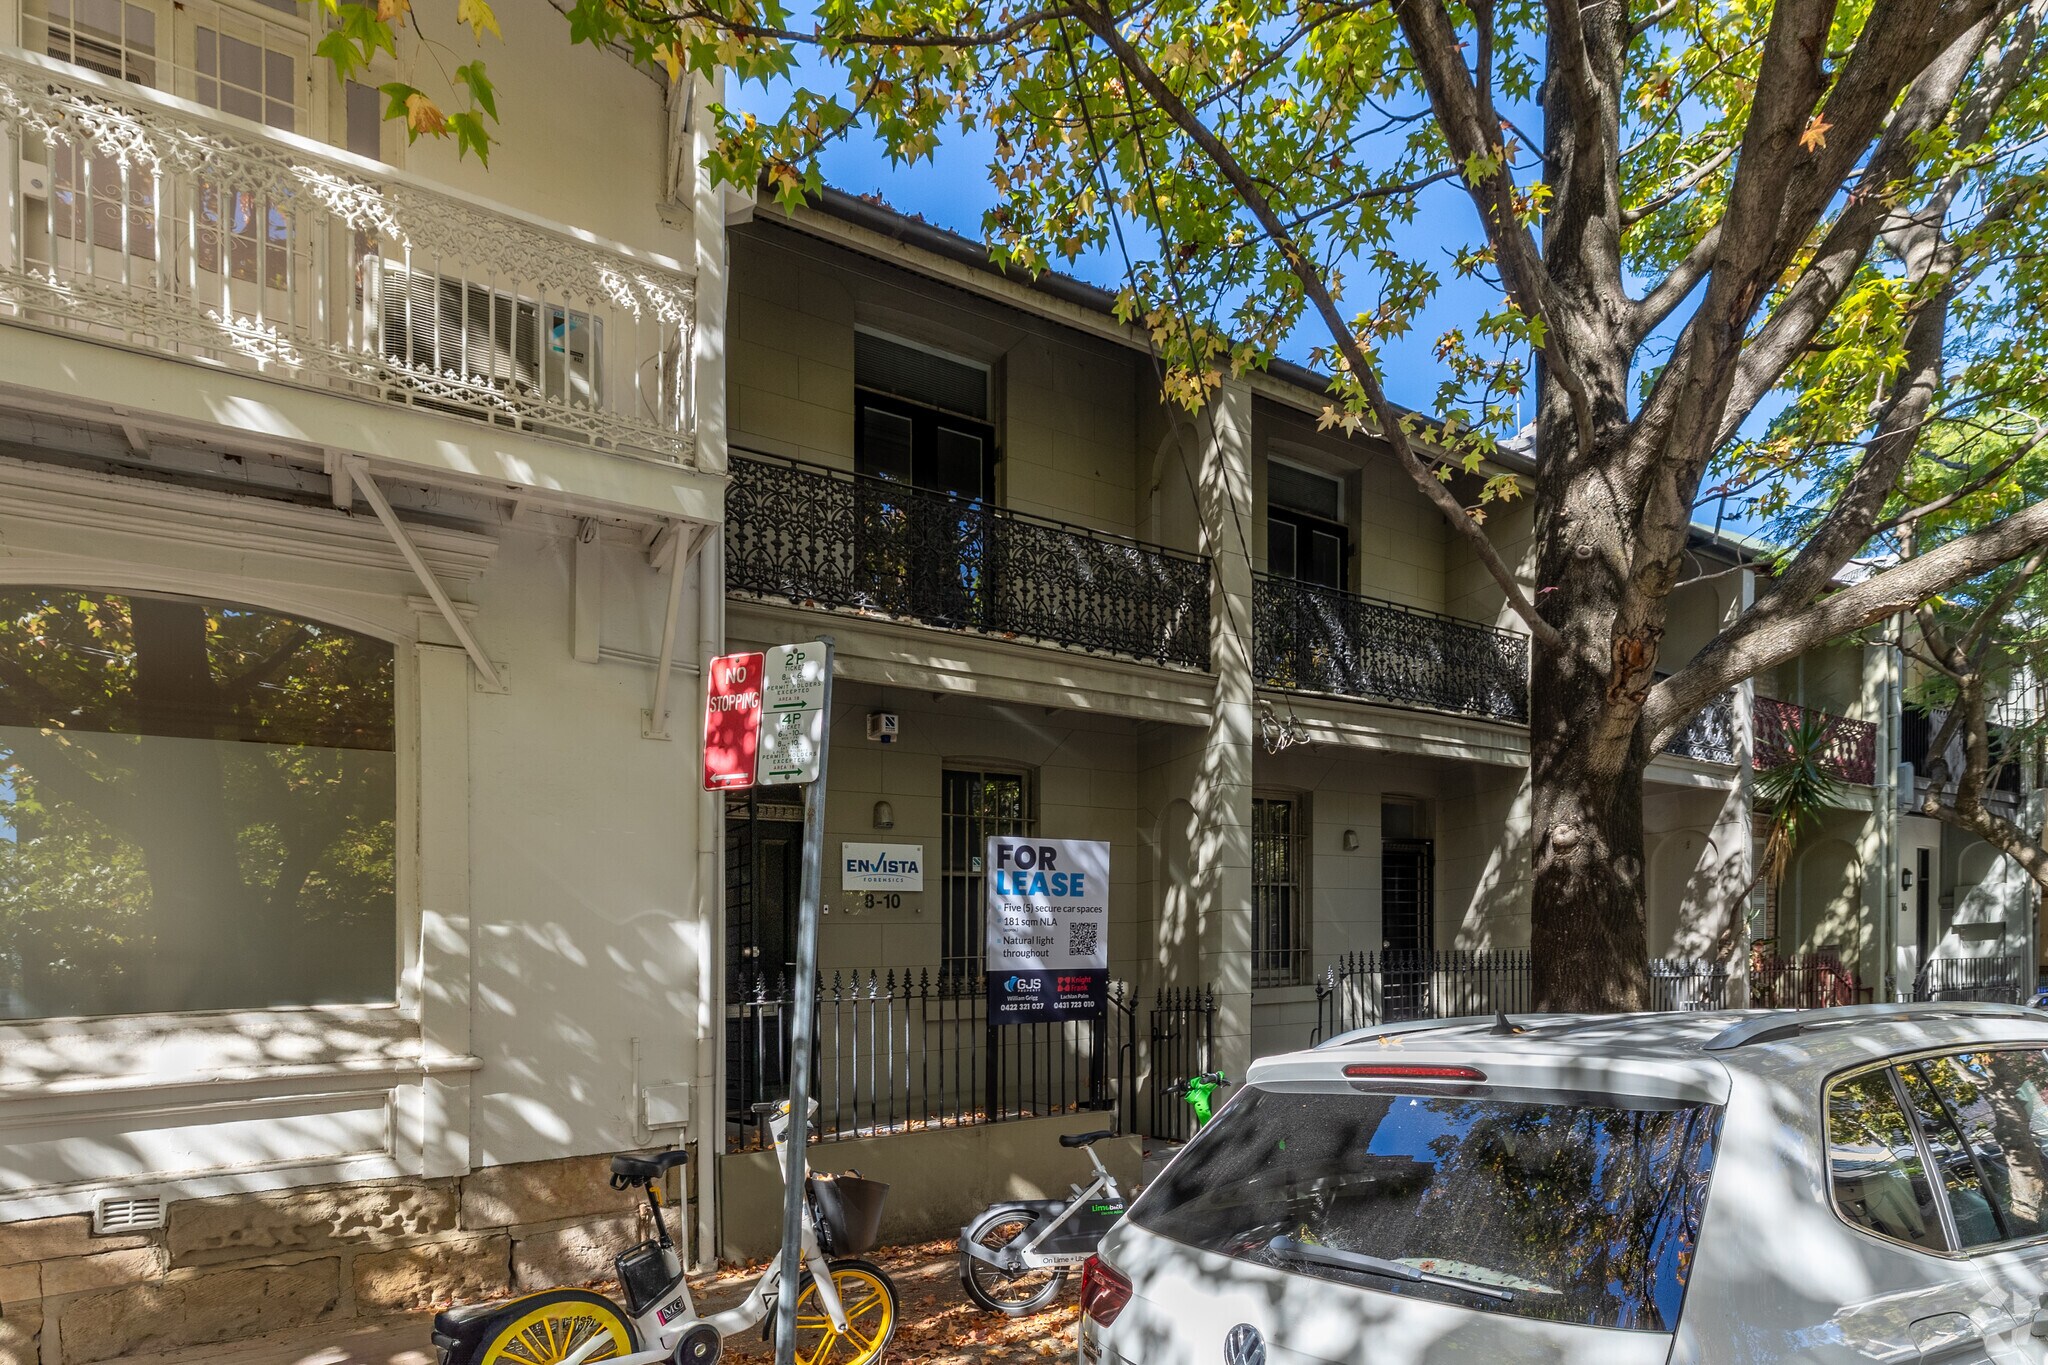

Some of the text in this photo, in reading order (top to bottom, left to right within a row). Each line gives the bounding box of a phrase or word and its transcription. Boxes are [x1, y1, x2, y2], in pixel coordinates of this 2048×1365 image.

[785, 652, 806, 666] 2P
[725, 667, 747, 685] NO
[710, 692, 759, 712] STOPPING
[782, 712, 802, 724] 4P
[781, 723, 801, 731] TICKET
[772, 757, 807, 765] EXCEPTED
[847, 852, 919, 874] ENVISTA
[997, 844, 1057, 871] FOR
[997, 871, 1084, 896] LEASE
[864, 893, 901, 909] 8-10
[1003, 903, 1021, 912] Five
[1023, 903, 1034, 914] (5)
[1035, 905, 1061, 913] secure
[1076, 906, 1103, 915] spaces
[1004, 917, 1058, 928] 181 sqm NLA
[1003, 936, 1055, 947] Natural light
[1003, 948, 1049, 959] throughout
[1017, 978, 1042, 990] GJS
[1071, 976, 1092, 984] Knight
[1071, 984, 1088, 992] Frank
[1000, 1002, 1045, 1011] 0422 321 037
[1070, 1001, 1082, 1009] 723
[1083, 1000, 1095, 1008] 010
[1053, 1256, 1070, 1264] Lime
[663, 1300, 683, 1318] MG
